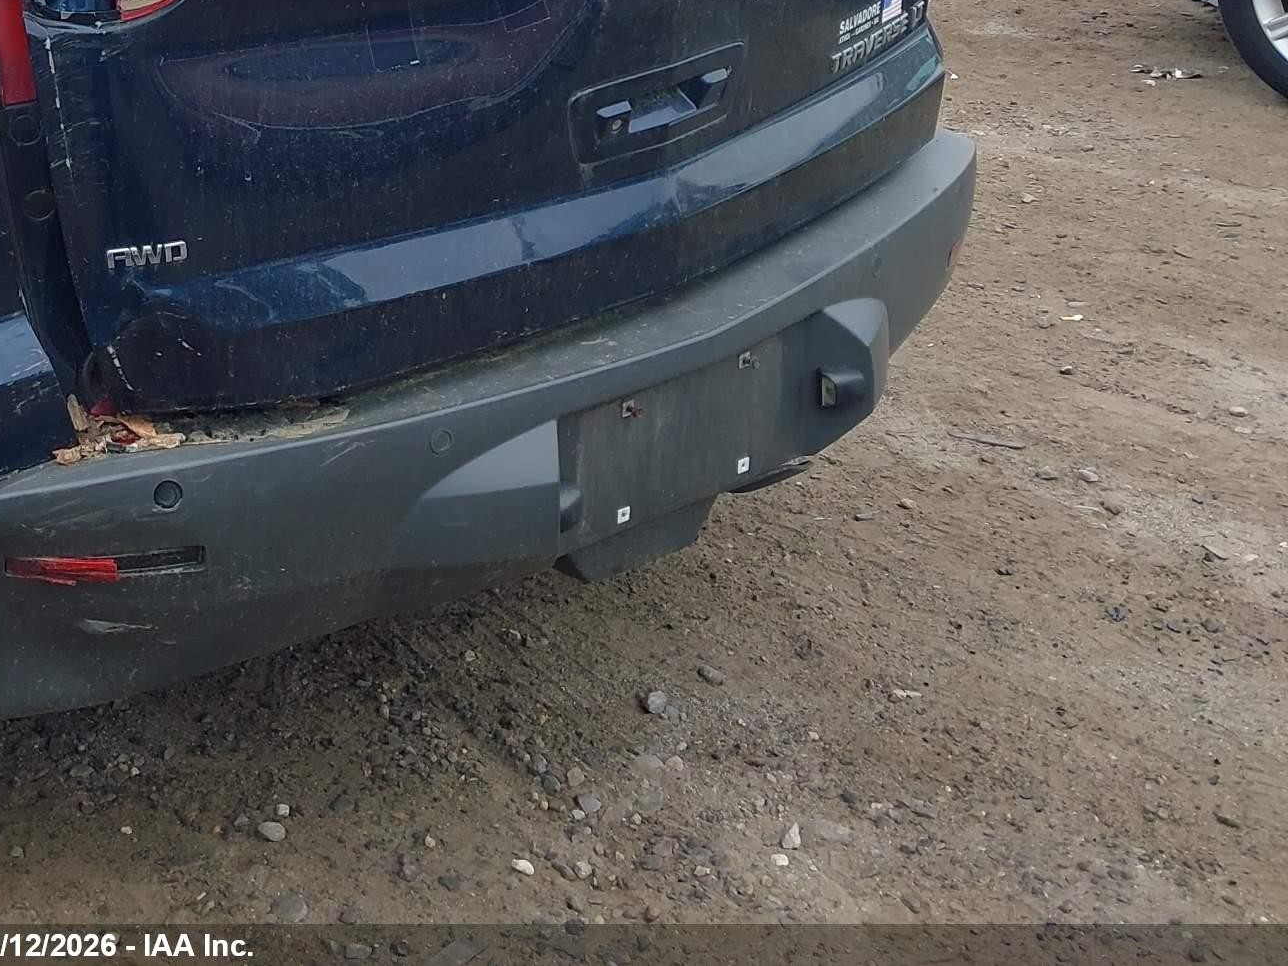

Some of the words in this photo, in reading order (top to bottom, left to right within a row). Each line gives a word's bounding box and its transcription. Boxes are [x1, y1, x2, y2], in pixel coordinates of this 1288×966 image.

[839, 1, 881, 34] SALVADORE
[832, 12, 908, 73] TRAVERSE
[911, 1, 924, 28] LT
[106, 240, 188, 269] AWD
